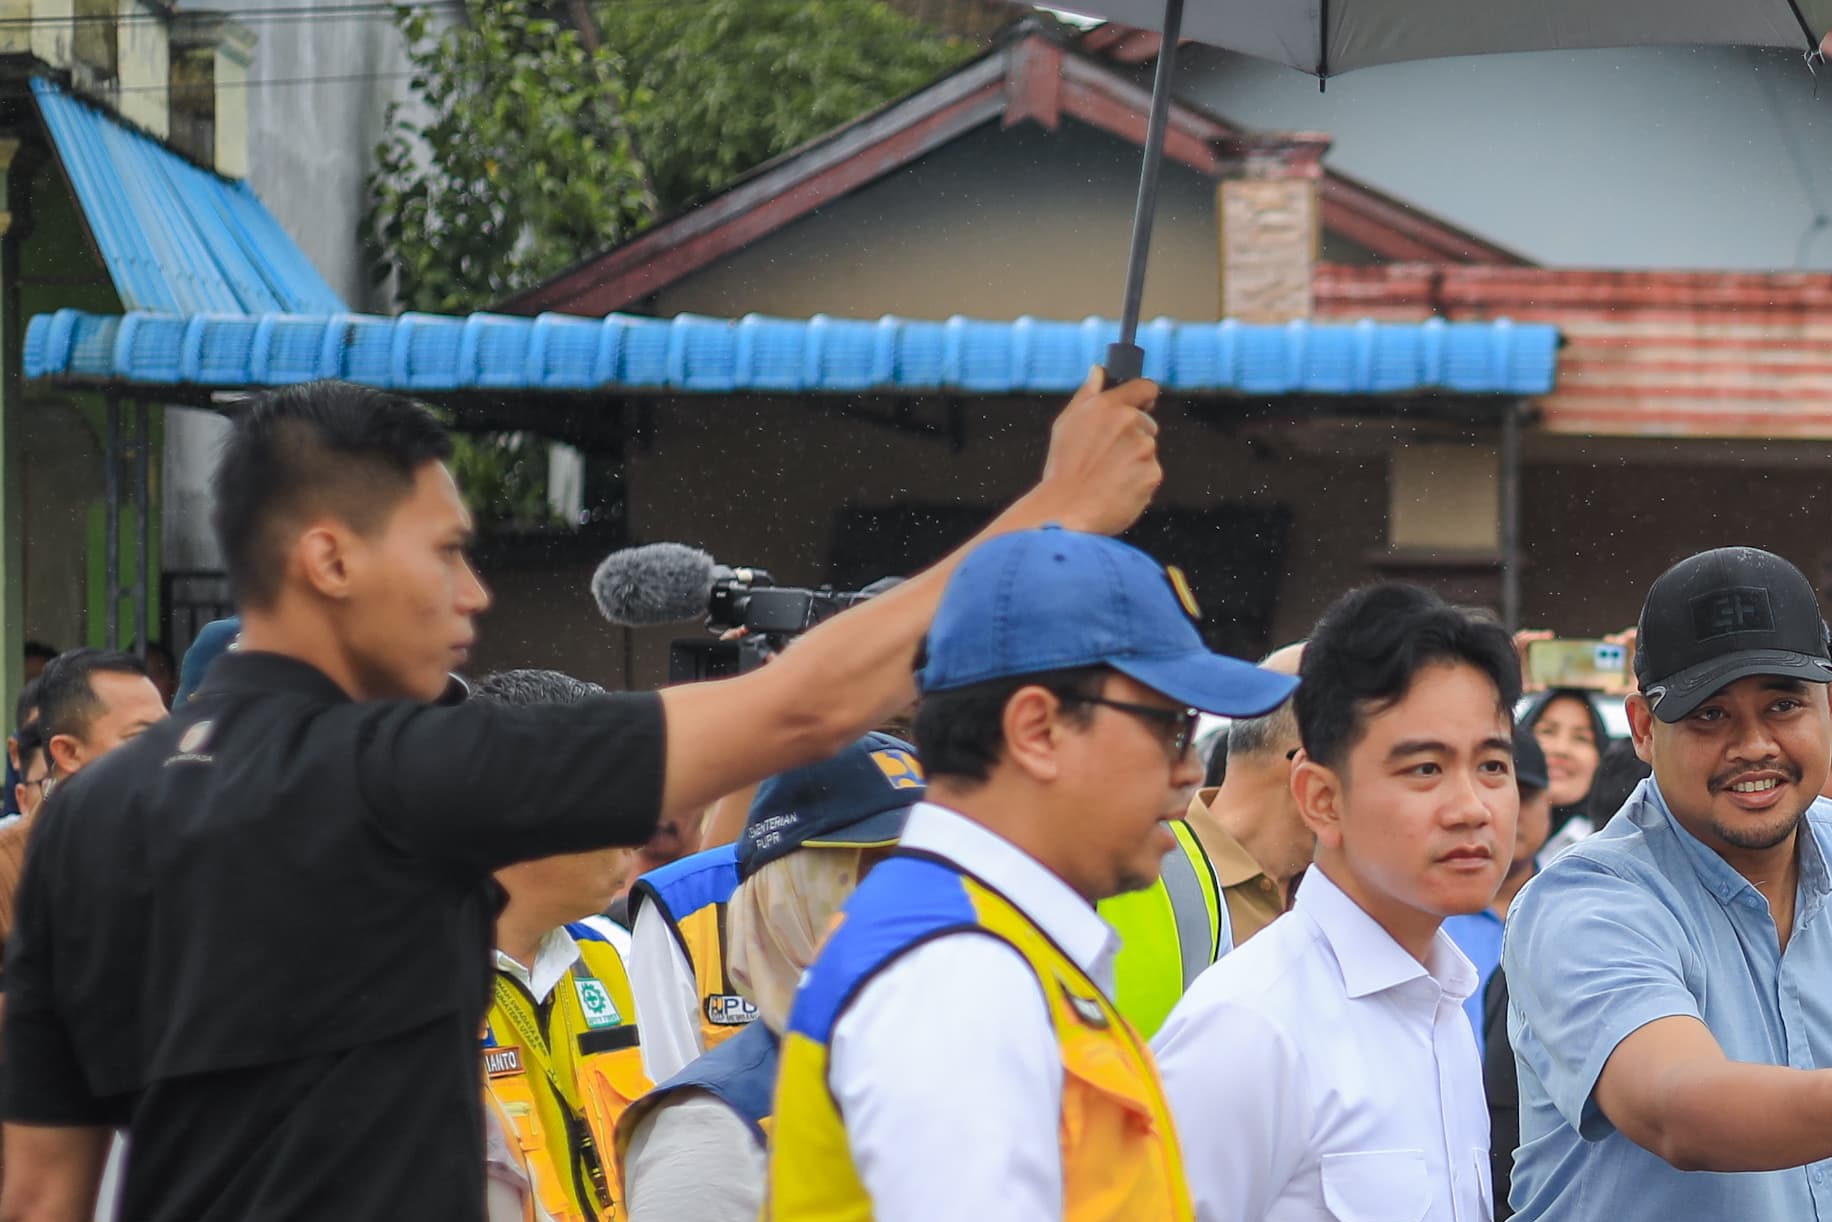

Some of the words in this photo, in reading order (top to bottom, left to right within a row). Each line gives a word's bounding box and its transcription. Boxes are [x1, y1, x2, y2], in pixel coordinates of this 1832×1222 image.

[756, 831, 779, 849] PUPR
[495, 988, 523, 1027] UMATERA
[724, 998, 758, 1014] PU
